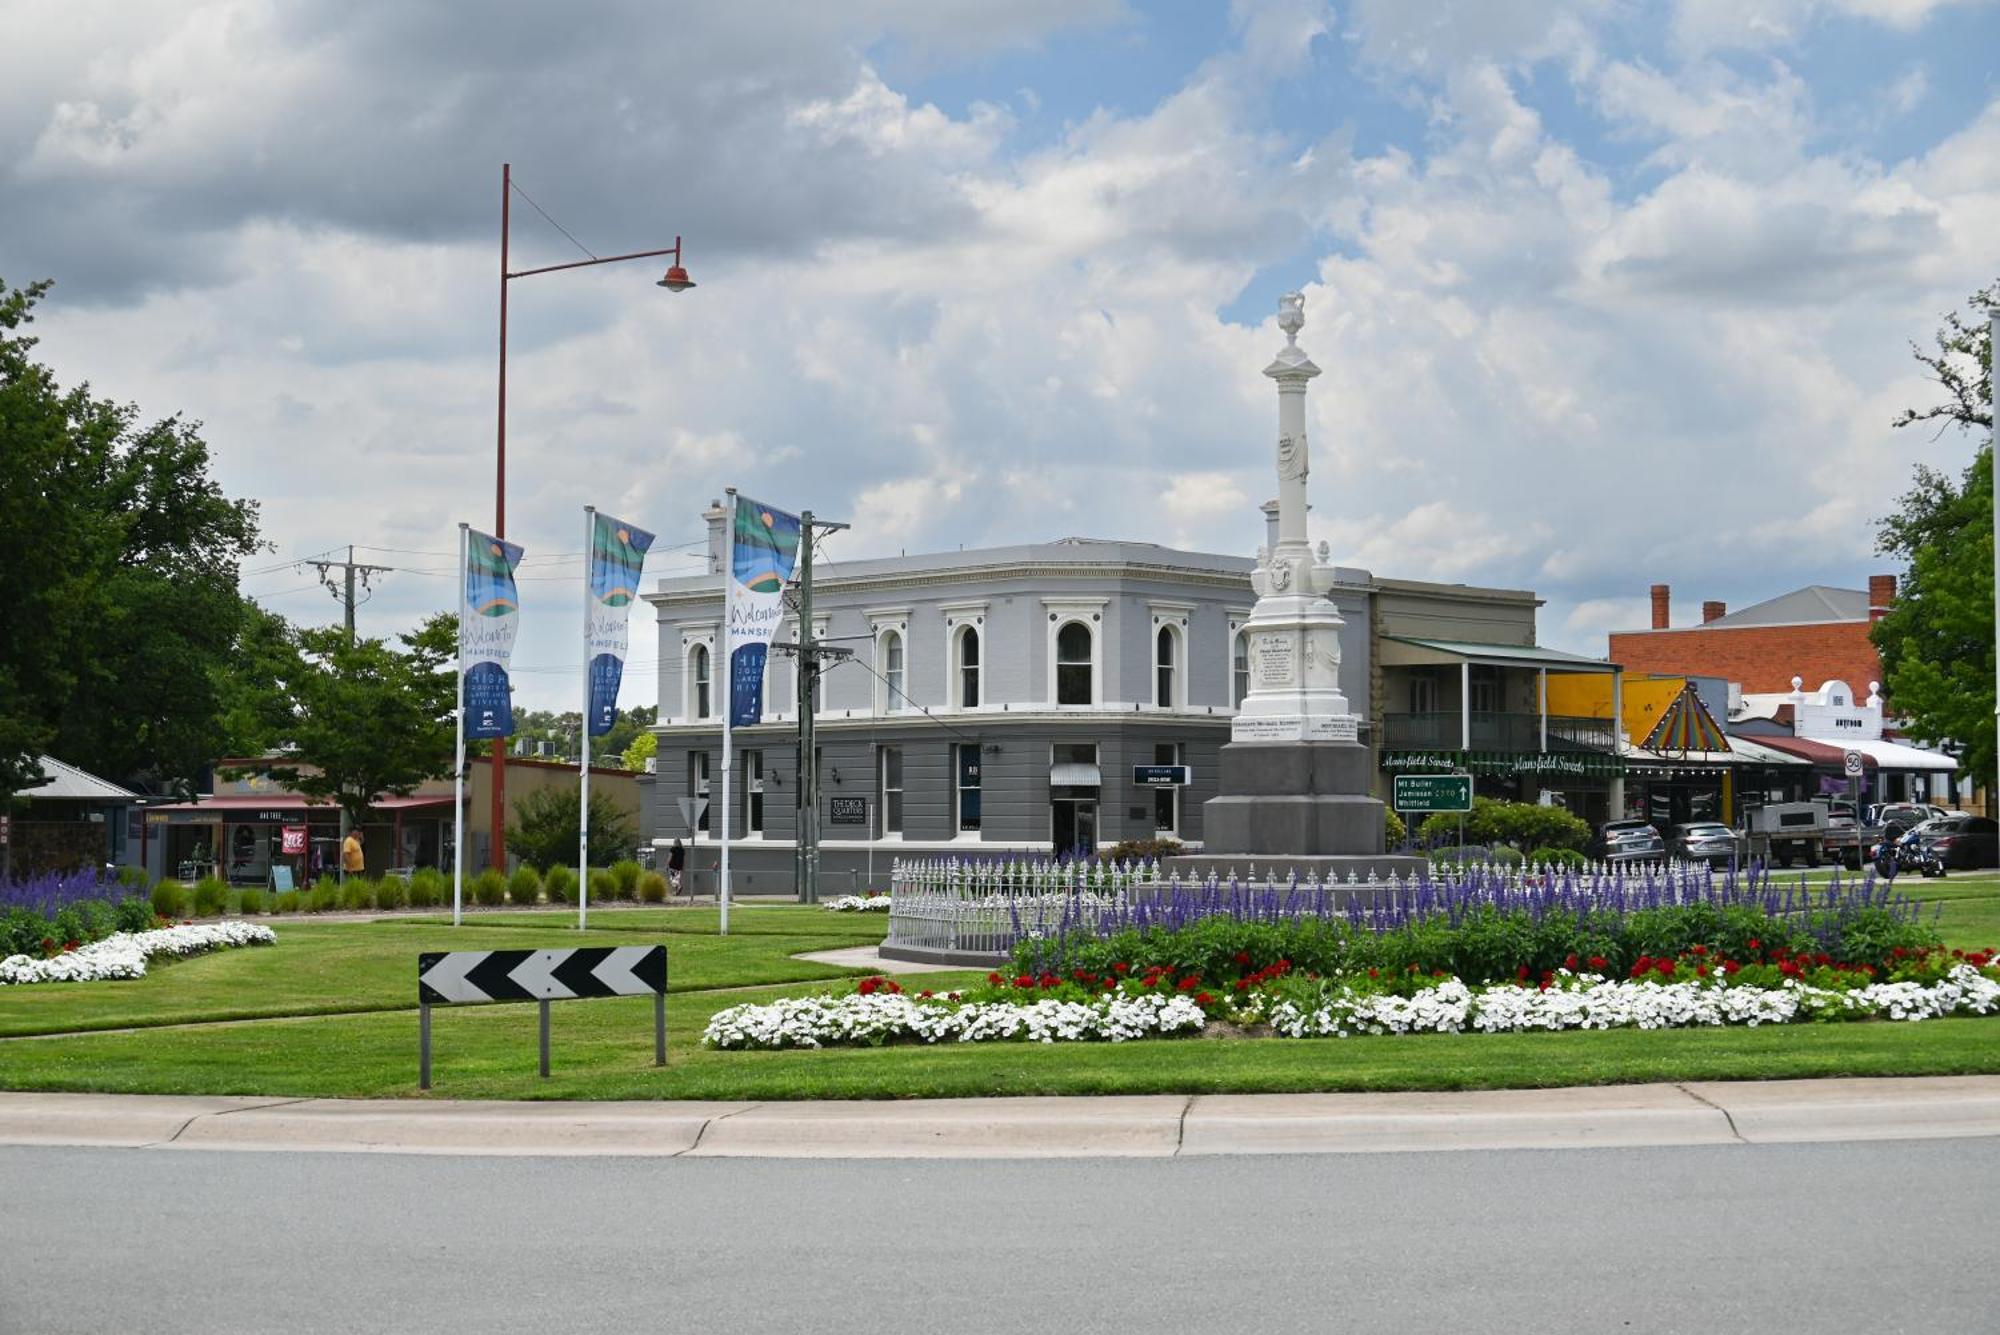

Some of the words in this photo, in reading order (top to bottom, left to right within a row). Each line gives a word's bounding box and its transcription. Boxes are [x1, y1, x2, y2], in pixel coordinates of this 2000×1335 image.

[1427, 755, 1454, 768] Sweets
[1512, 755, 1557, 774] Mansfield
[1558, 755, 1585, 774] Sweets
[1398, 780, 1408, 788] Mt
